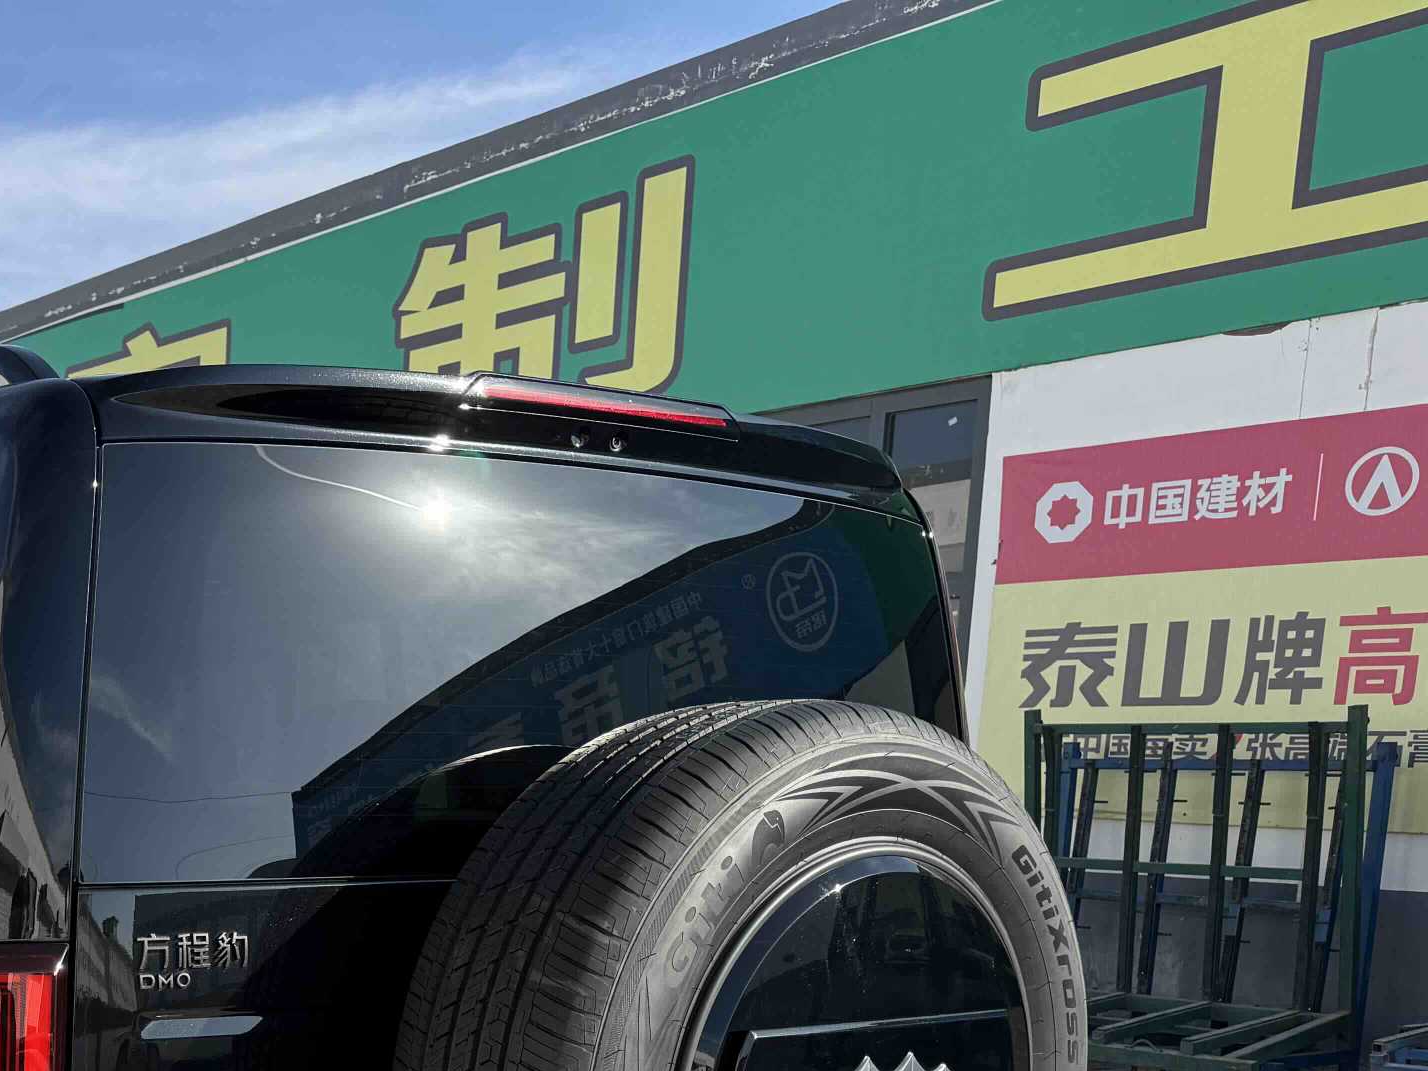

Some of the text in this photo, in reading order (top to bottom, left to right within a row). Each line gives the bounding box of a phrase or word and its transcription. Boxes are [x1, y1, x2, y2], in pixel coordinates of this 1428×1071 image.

[1103, 467, 1292, 530] 中国建材
[1018, 606, 1428, 709] 泰山牌高
[137, 932, 249, 969] 方程豹
[139, 972, 191, 990] DMO
